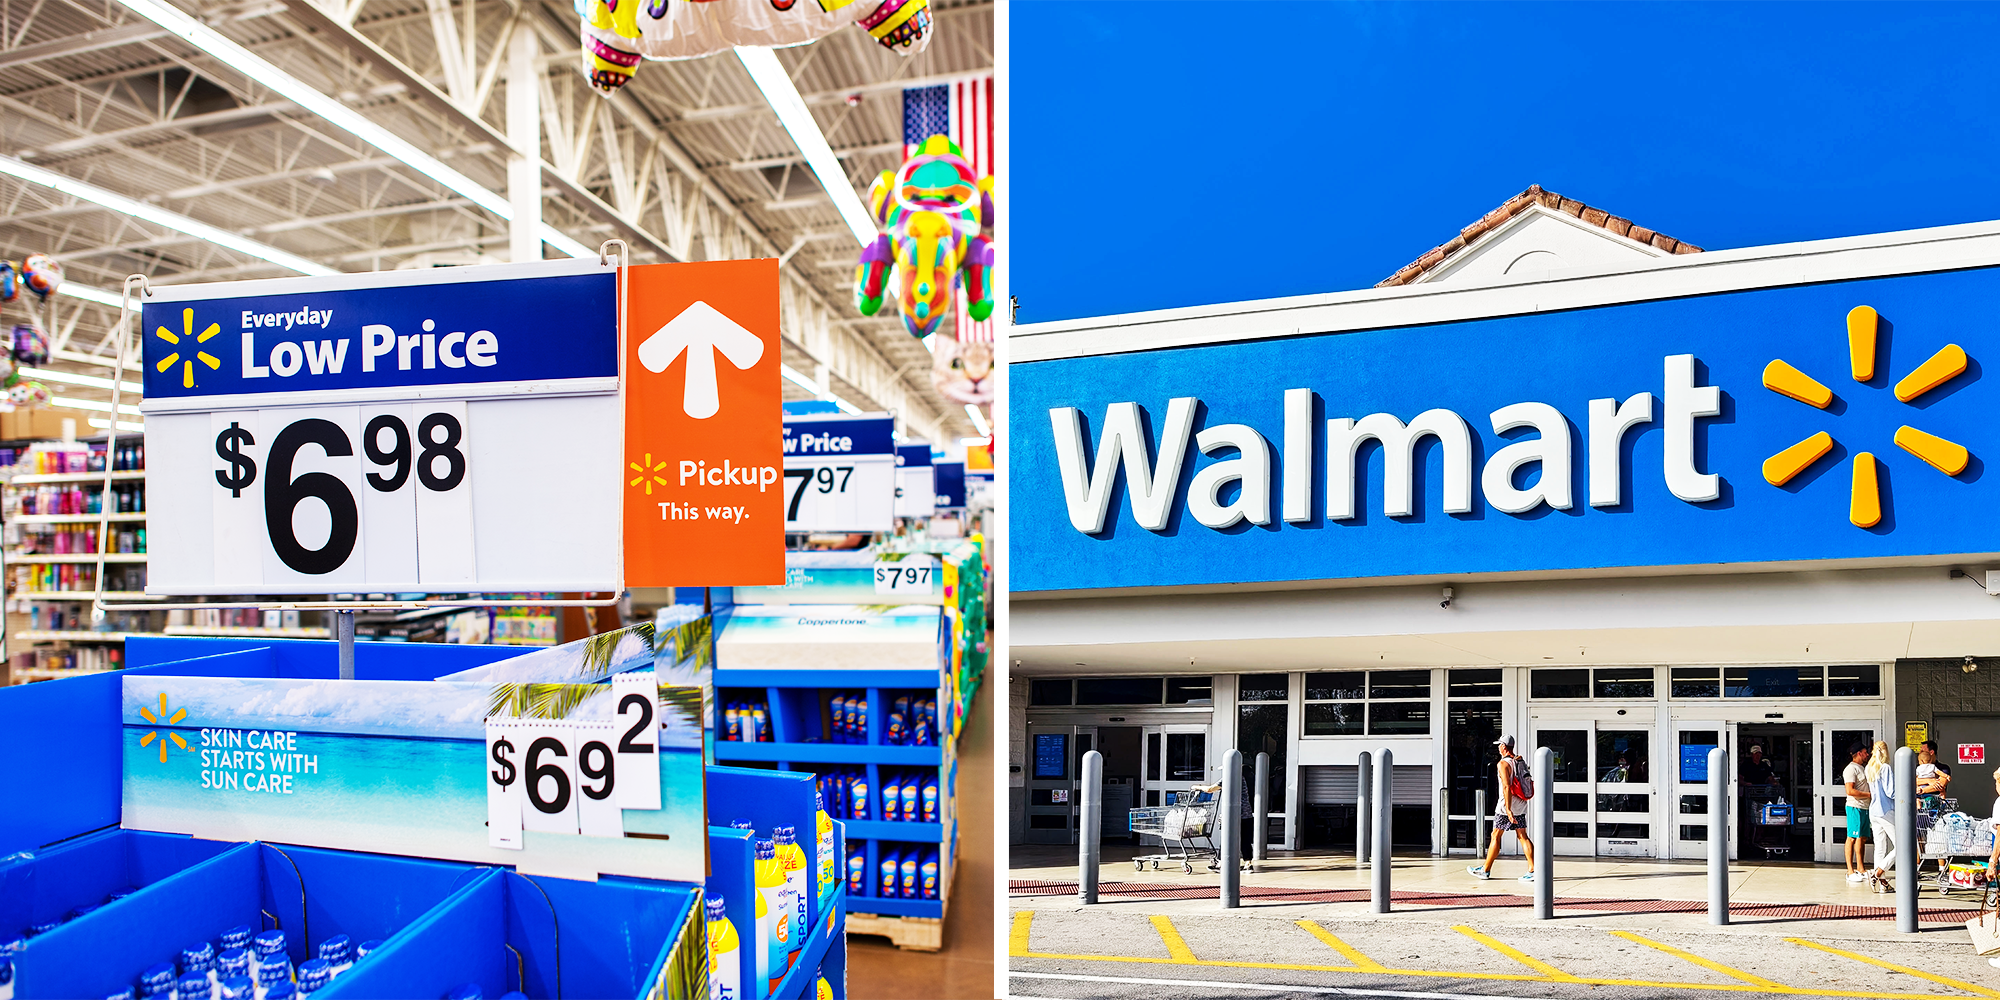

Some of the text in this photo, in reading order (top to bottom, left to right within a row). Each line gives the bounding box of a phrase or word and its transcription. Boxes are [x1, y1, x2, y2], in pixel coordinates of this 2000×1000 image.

[241, 306, 333, 332] Everyday
[241, 319, 499, 379] Low Price
[801, 432, 853, 452] Price
[1049, 354, 1721, 535] Walmart
[679, 459, 778, 493] Pickup
[657, 502, 750, 525] This way.
[797, 617, 867, 626] Coppertone
[1765, 678, 1780, 686] Exit
[200, 728, 297, 751] SKIN CARE
[200, 749, 318, 774] STARTS WITH
[200, 770, 293, 794] SUN CARE
[797, 894, 807, 946] SPORT
